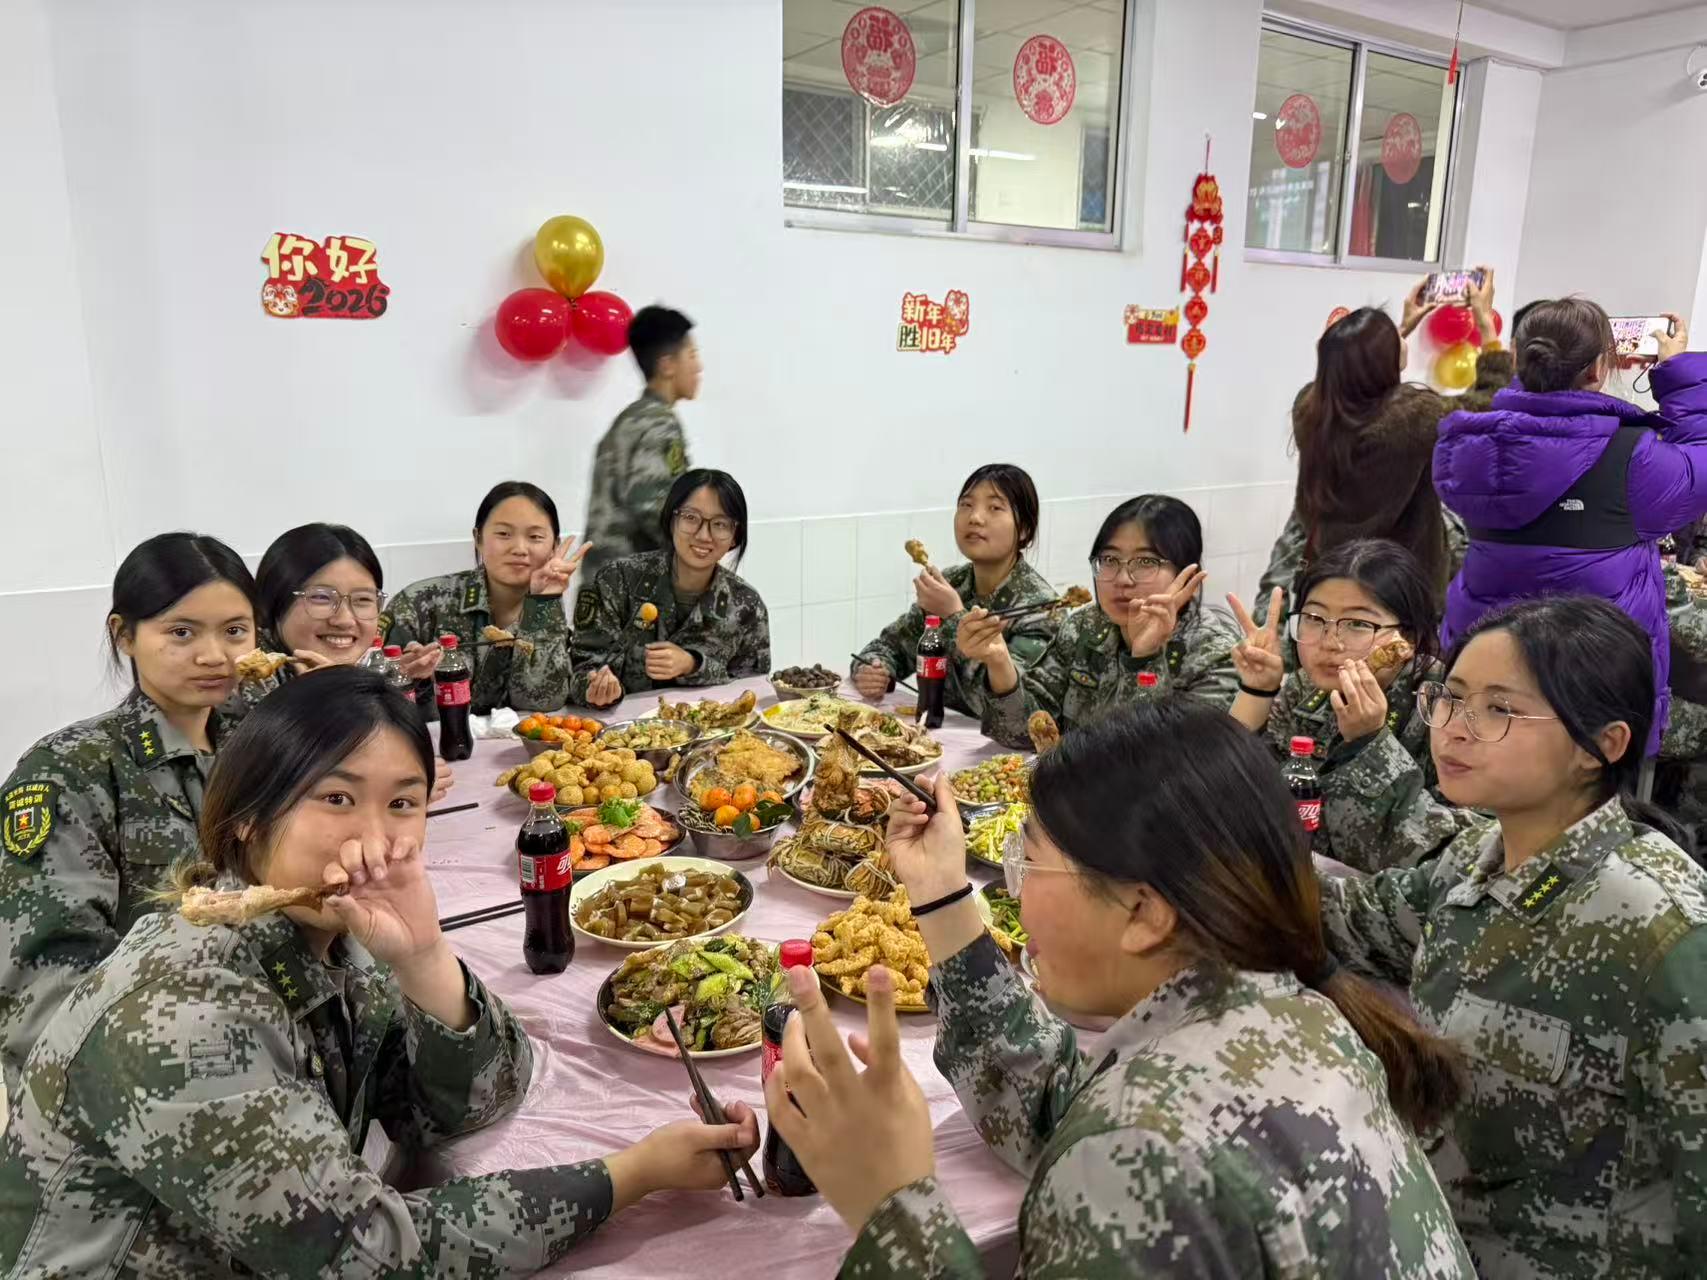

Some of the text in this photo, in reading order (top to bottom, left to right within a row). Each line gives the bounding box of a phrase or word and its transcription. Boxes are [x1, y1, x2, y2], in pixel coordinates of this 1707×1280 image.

[261, 234, 378, 284] 你好
[298, 278, 390, 316] 2026
[903, 293, 943, 325] 新年
[899, 324, 955, 353] 胜旧年
